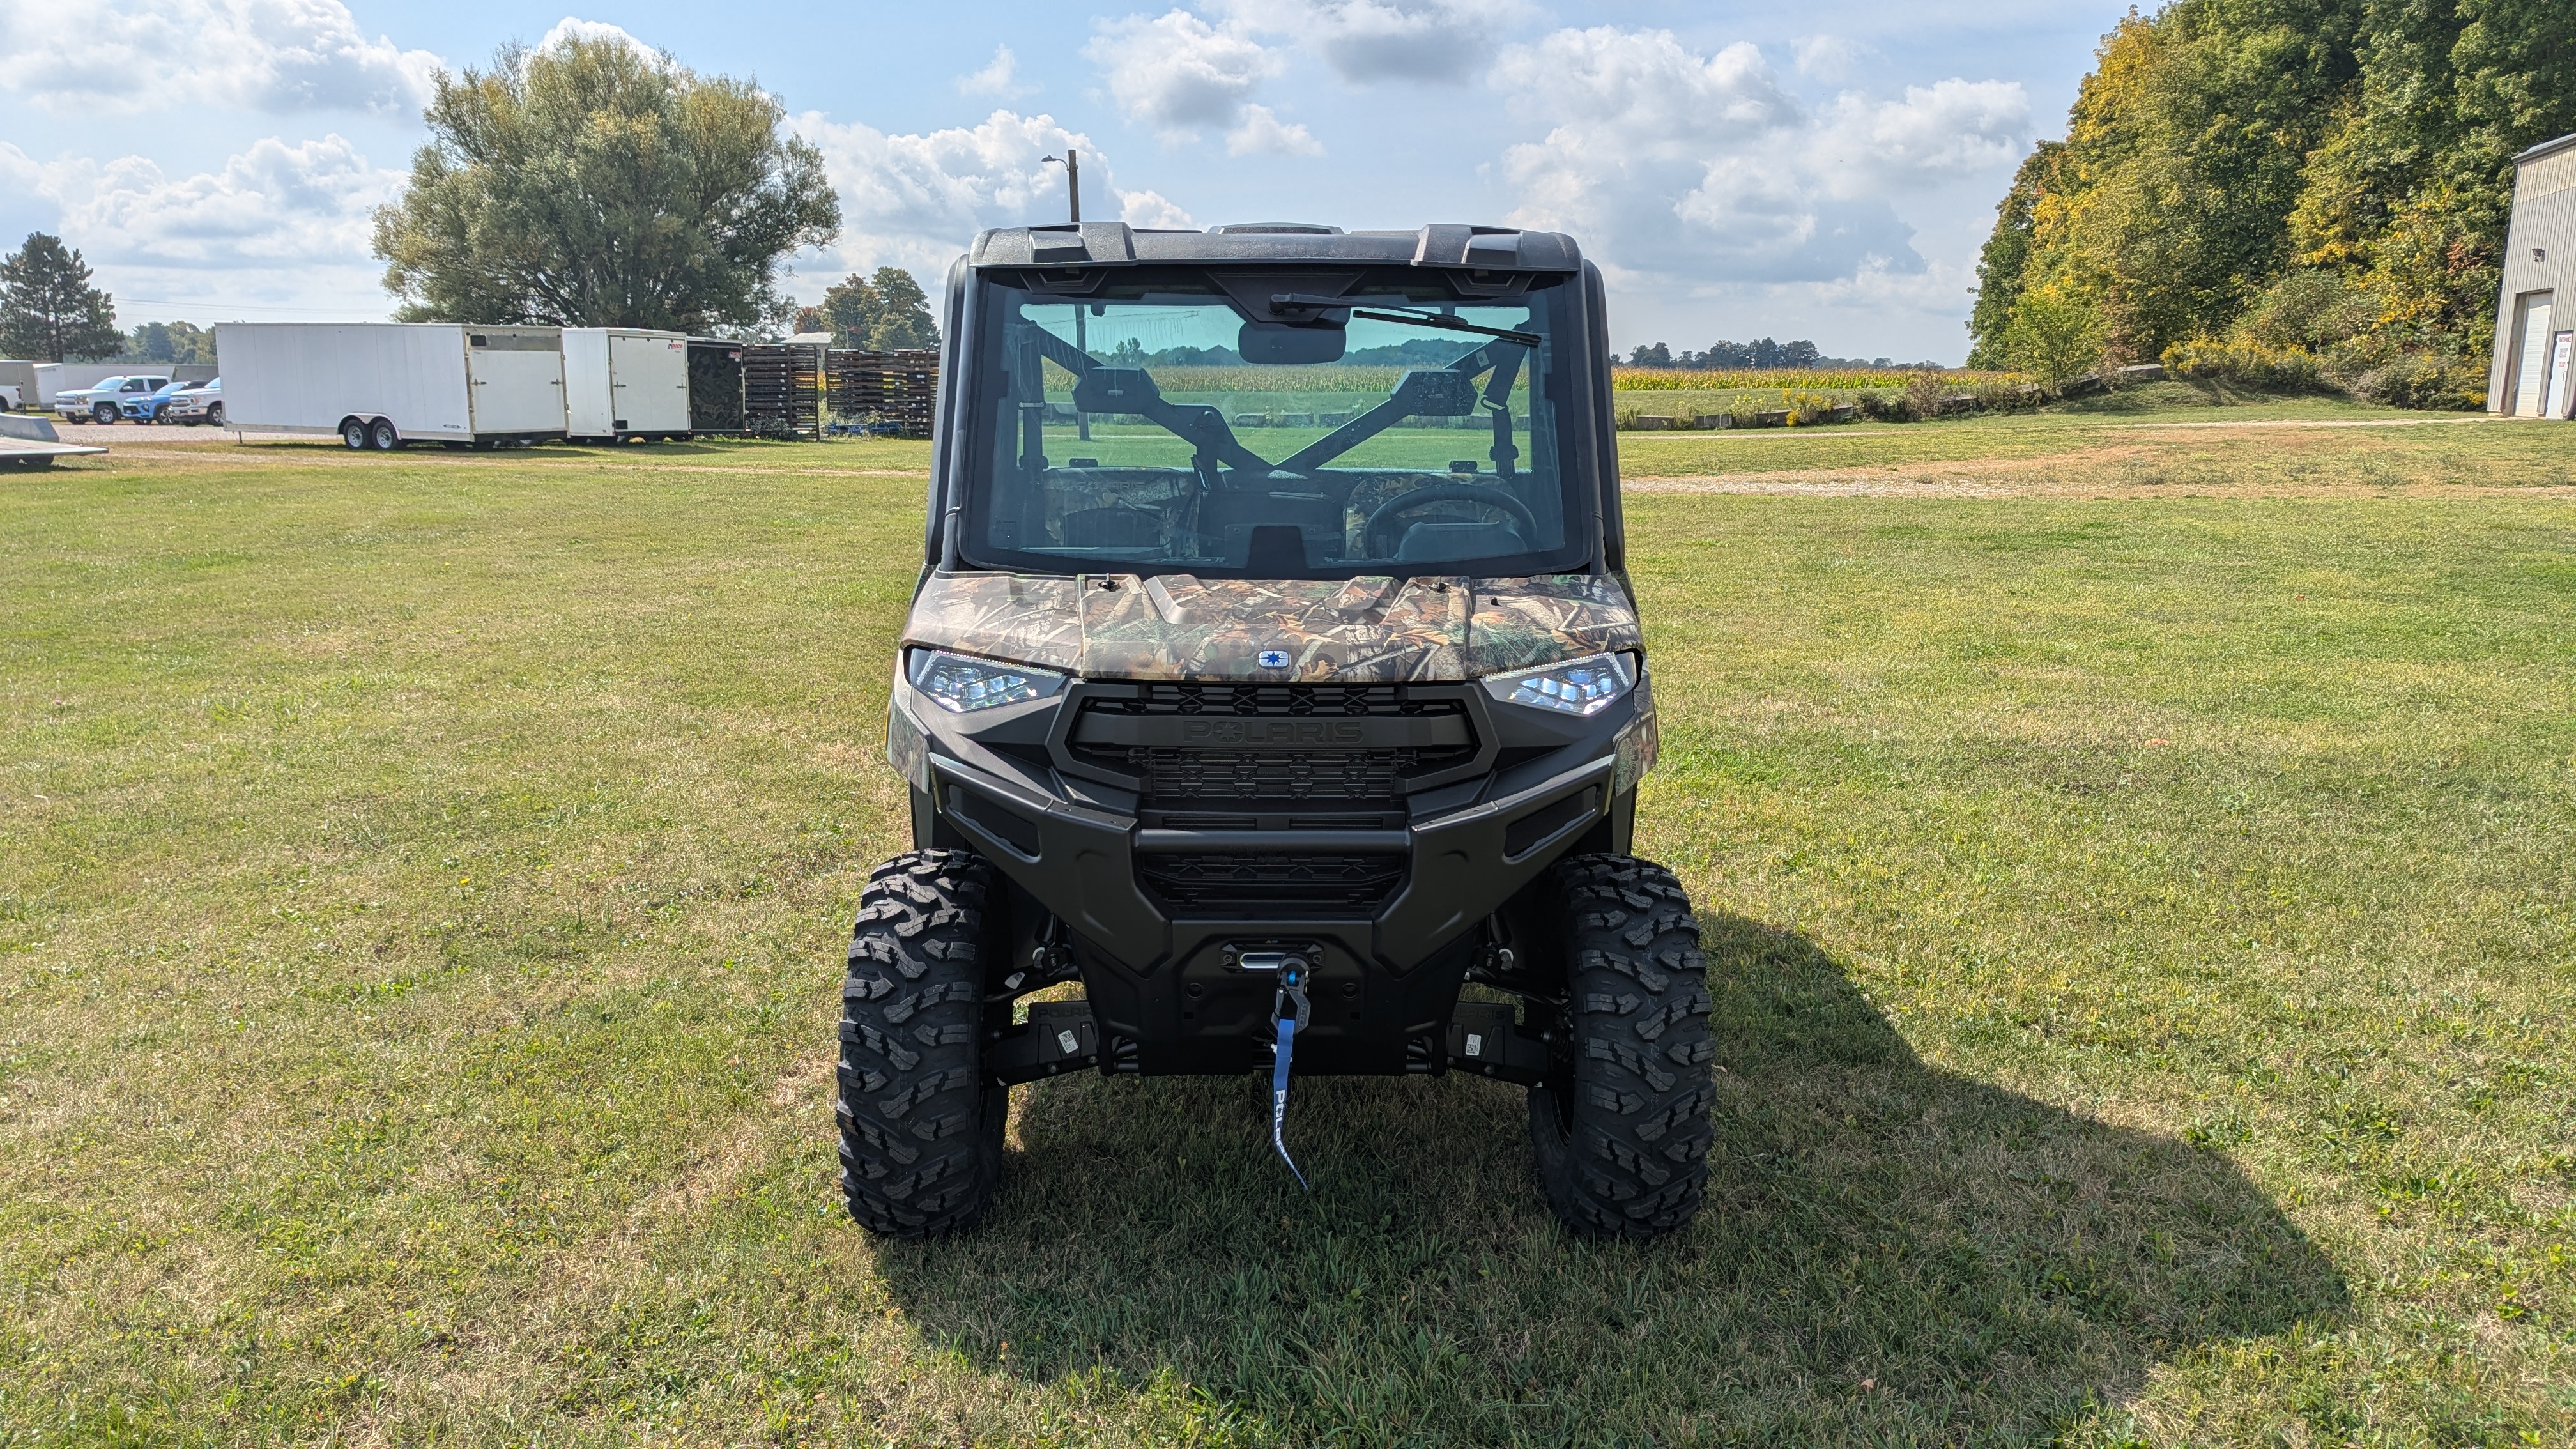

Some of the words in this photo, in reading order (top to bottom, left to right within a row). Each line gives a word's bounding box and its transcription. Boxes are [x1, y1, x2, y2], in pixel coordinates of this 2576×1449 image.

[1183, 721, 1363, 744] POLARIS
[1038, 1007, 1092, 1018] POLAR
[1453, 1008, 1505, 1020] LARIS
[1275, 1089, 1292, 1167] POLARI
